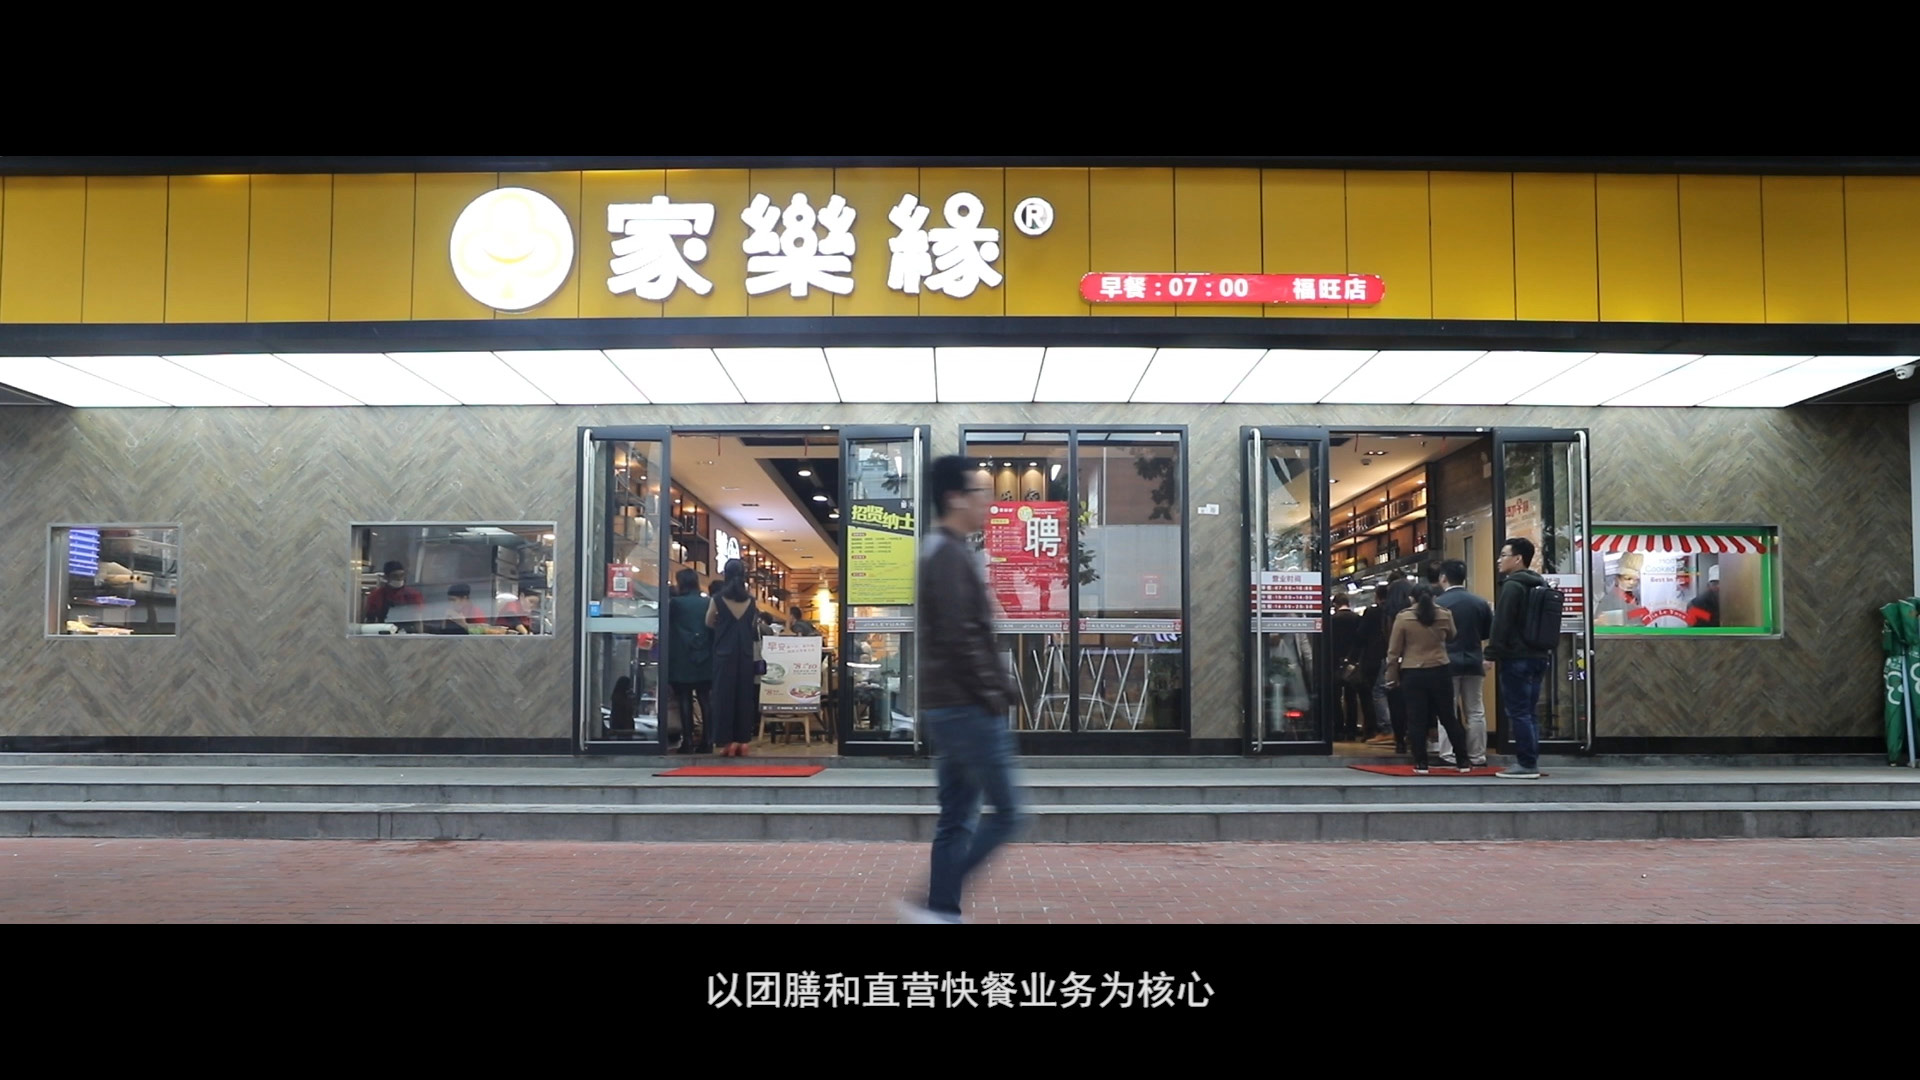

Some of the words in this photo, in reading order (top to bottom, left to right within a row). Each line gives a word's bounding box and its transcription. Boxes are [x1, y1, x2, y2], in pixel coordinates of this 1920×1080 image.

[1292, 277, 1367, 301] 福旺店
[851, 505, 915, 530] 招贤纳士
[1024, 515, 1062, 557] 聘
